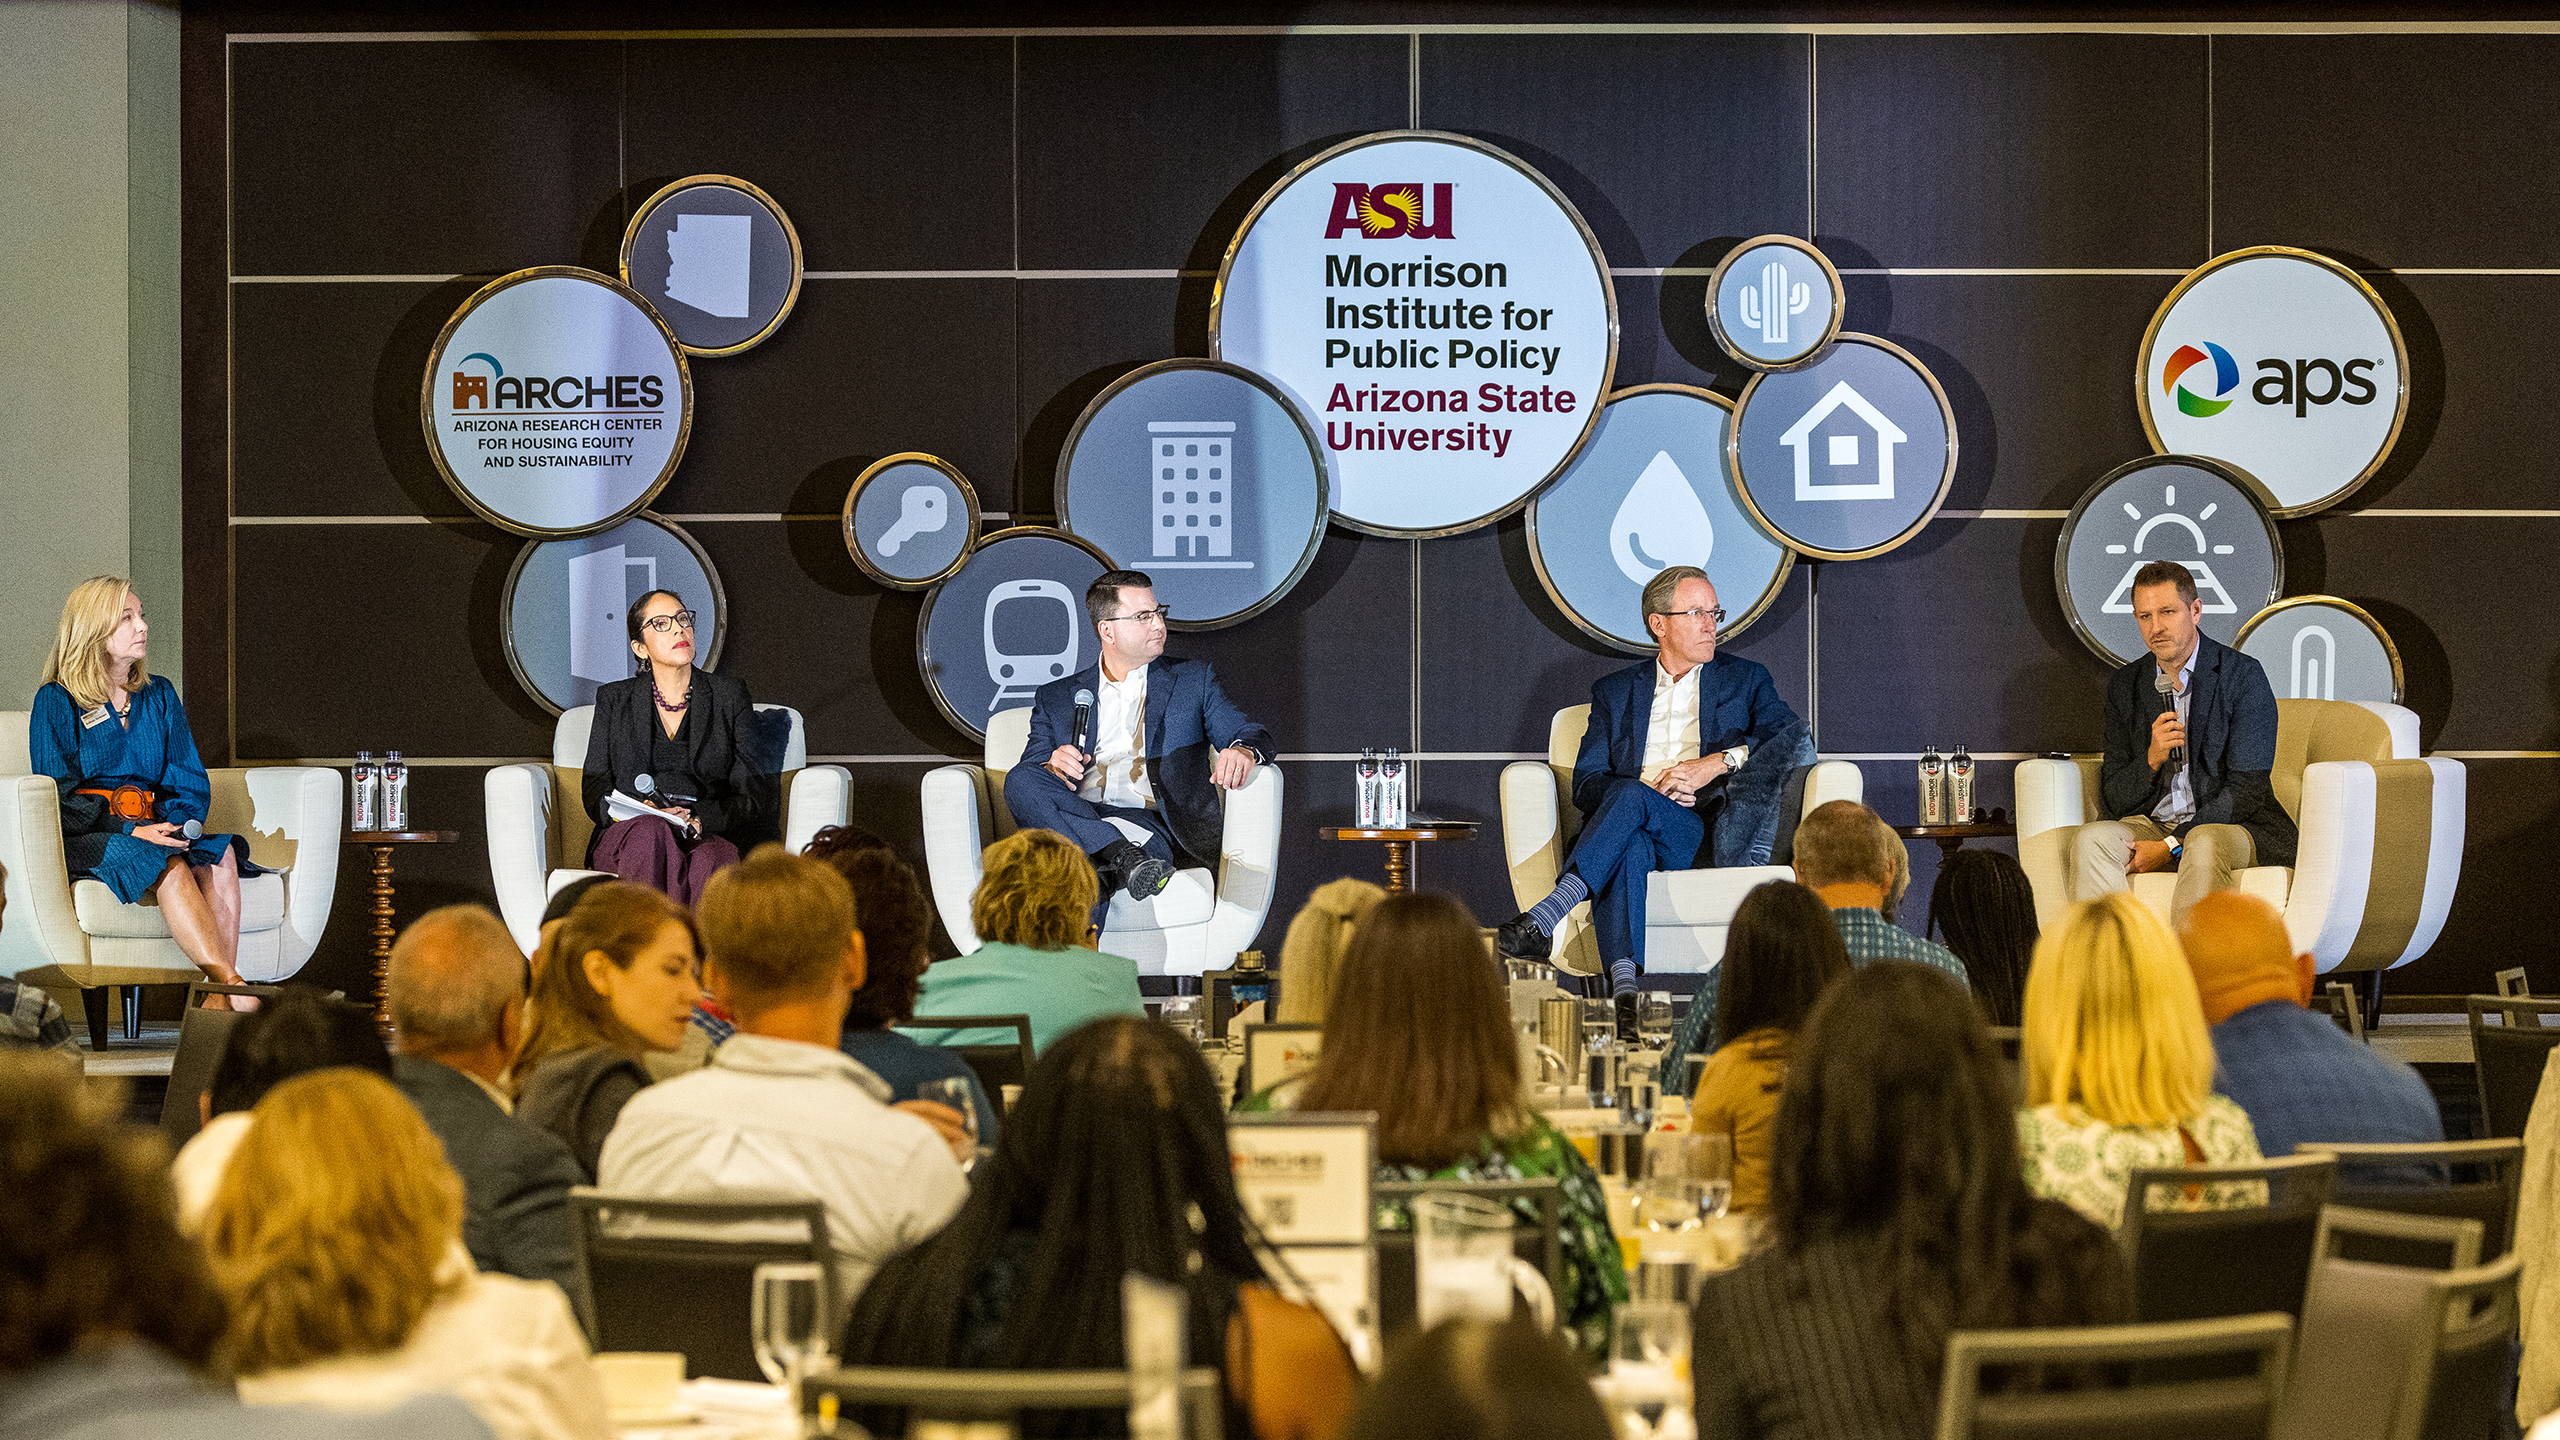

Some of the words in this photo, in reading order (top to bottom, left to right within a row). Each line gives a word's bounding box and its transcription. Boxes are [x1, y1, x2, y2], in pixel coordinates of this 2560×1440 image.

[1324, 182, 1456, 240] ASU
[1326, 254, 1507, 287] Morrison
[1326, 296, 1493, 330] Institute
[1501, 301, 1553, 331] for
[1326, 339, 1439, 368] Public
[1448, 339, 1561, 375] Policy
[495, 375, 664, 409] ARCHES
[1326, 383, 1468, 412] Arizona
[1477, 382, 1576, 413] State
[453, 420, 518, 432] ARIZONA
[522, 419, 600, 431] RESEARCH
[604, 418, 662, 430] CENTER
[1327, 421, 1512, 457] University
[478, 438, 507, 450] FOR
[512, 437, 578, 449] HOUSING
[582, 437, 635, 449] EQUITY
[484, 456, 515, 468] AND
[518, 454, 633, 467] SUSTAINABILITY
[1958, 778, 1966, 816] BODYARMOR
